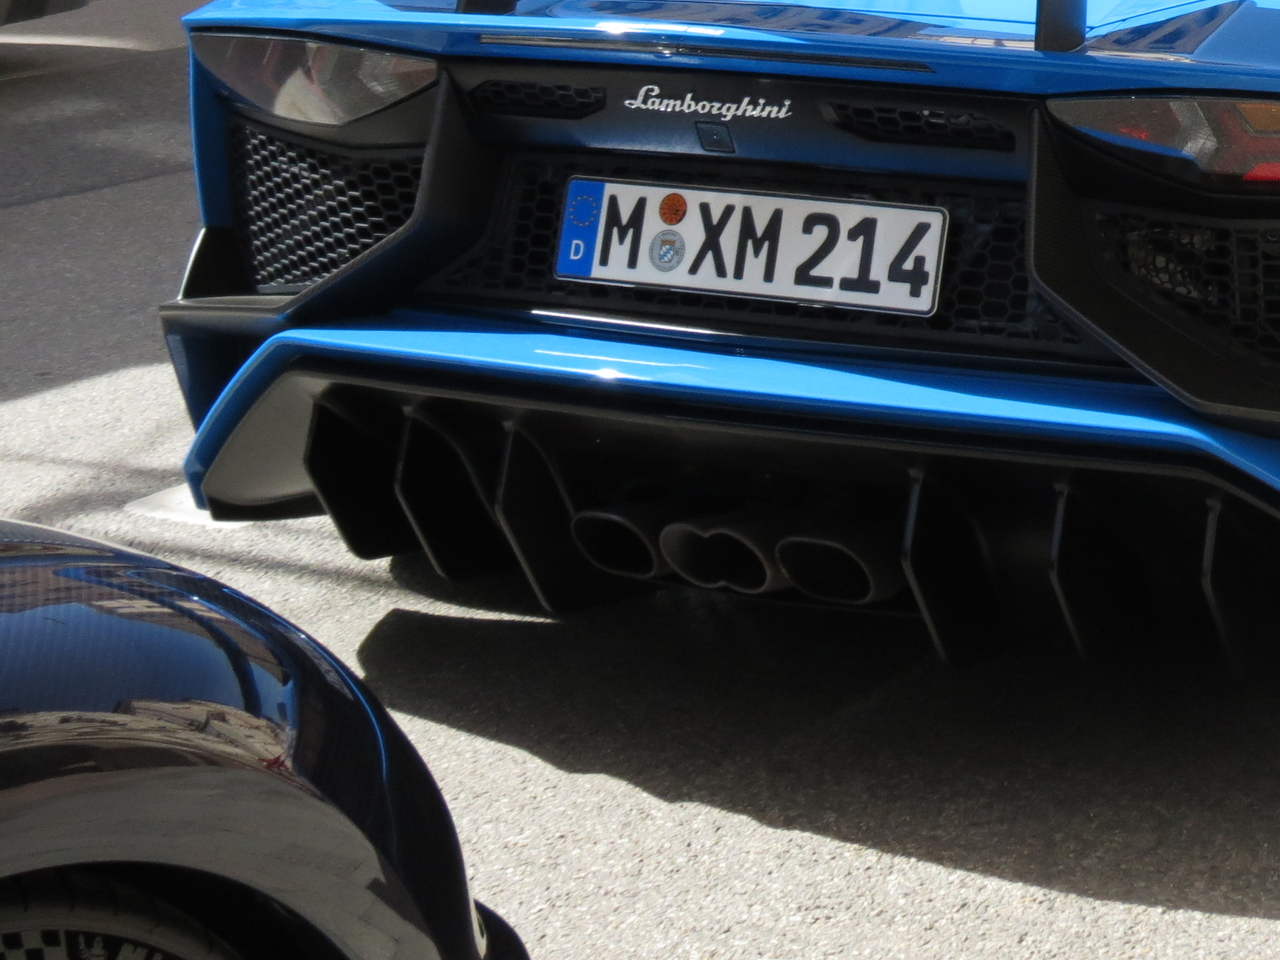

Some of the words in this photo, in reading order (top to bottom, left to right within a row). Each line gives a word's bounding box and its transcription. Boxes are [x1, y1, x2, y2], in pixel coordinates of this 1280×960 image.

[623, 85, 792, 121] Lamborghini
[569, 240, 584, 261] D
[599, 194, 647, 270] M
[688, 202, 784, 283] XM
[793, 212, 932, 299] 214
